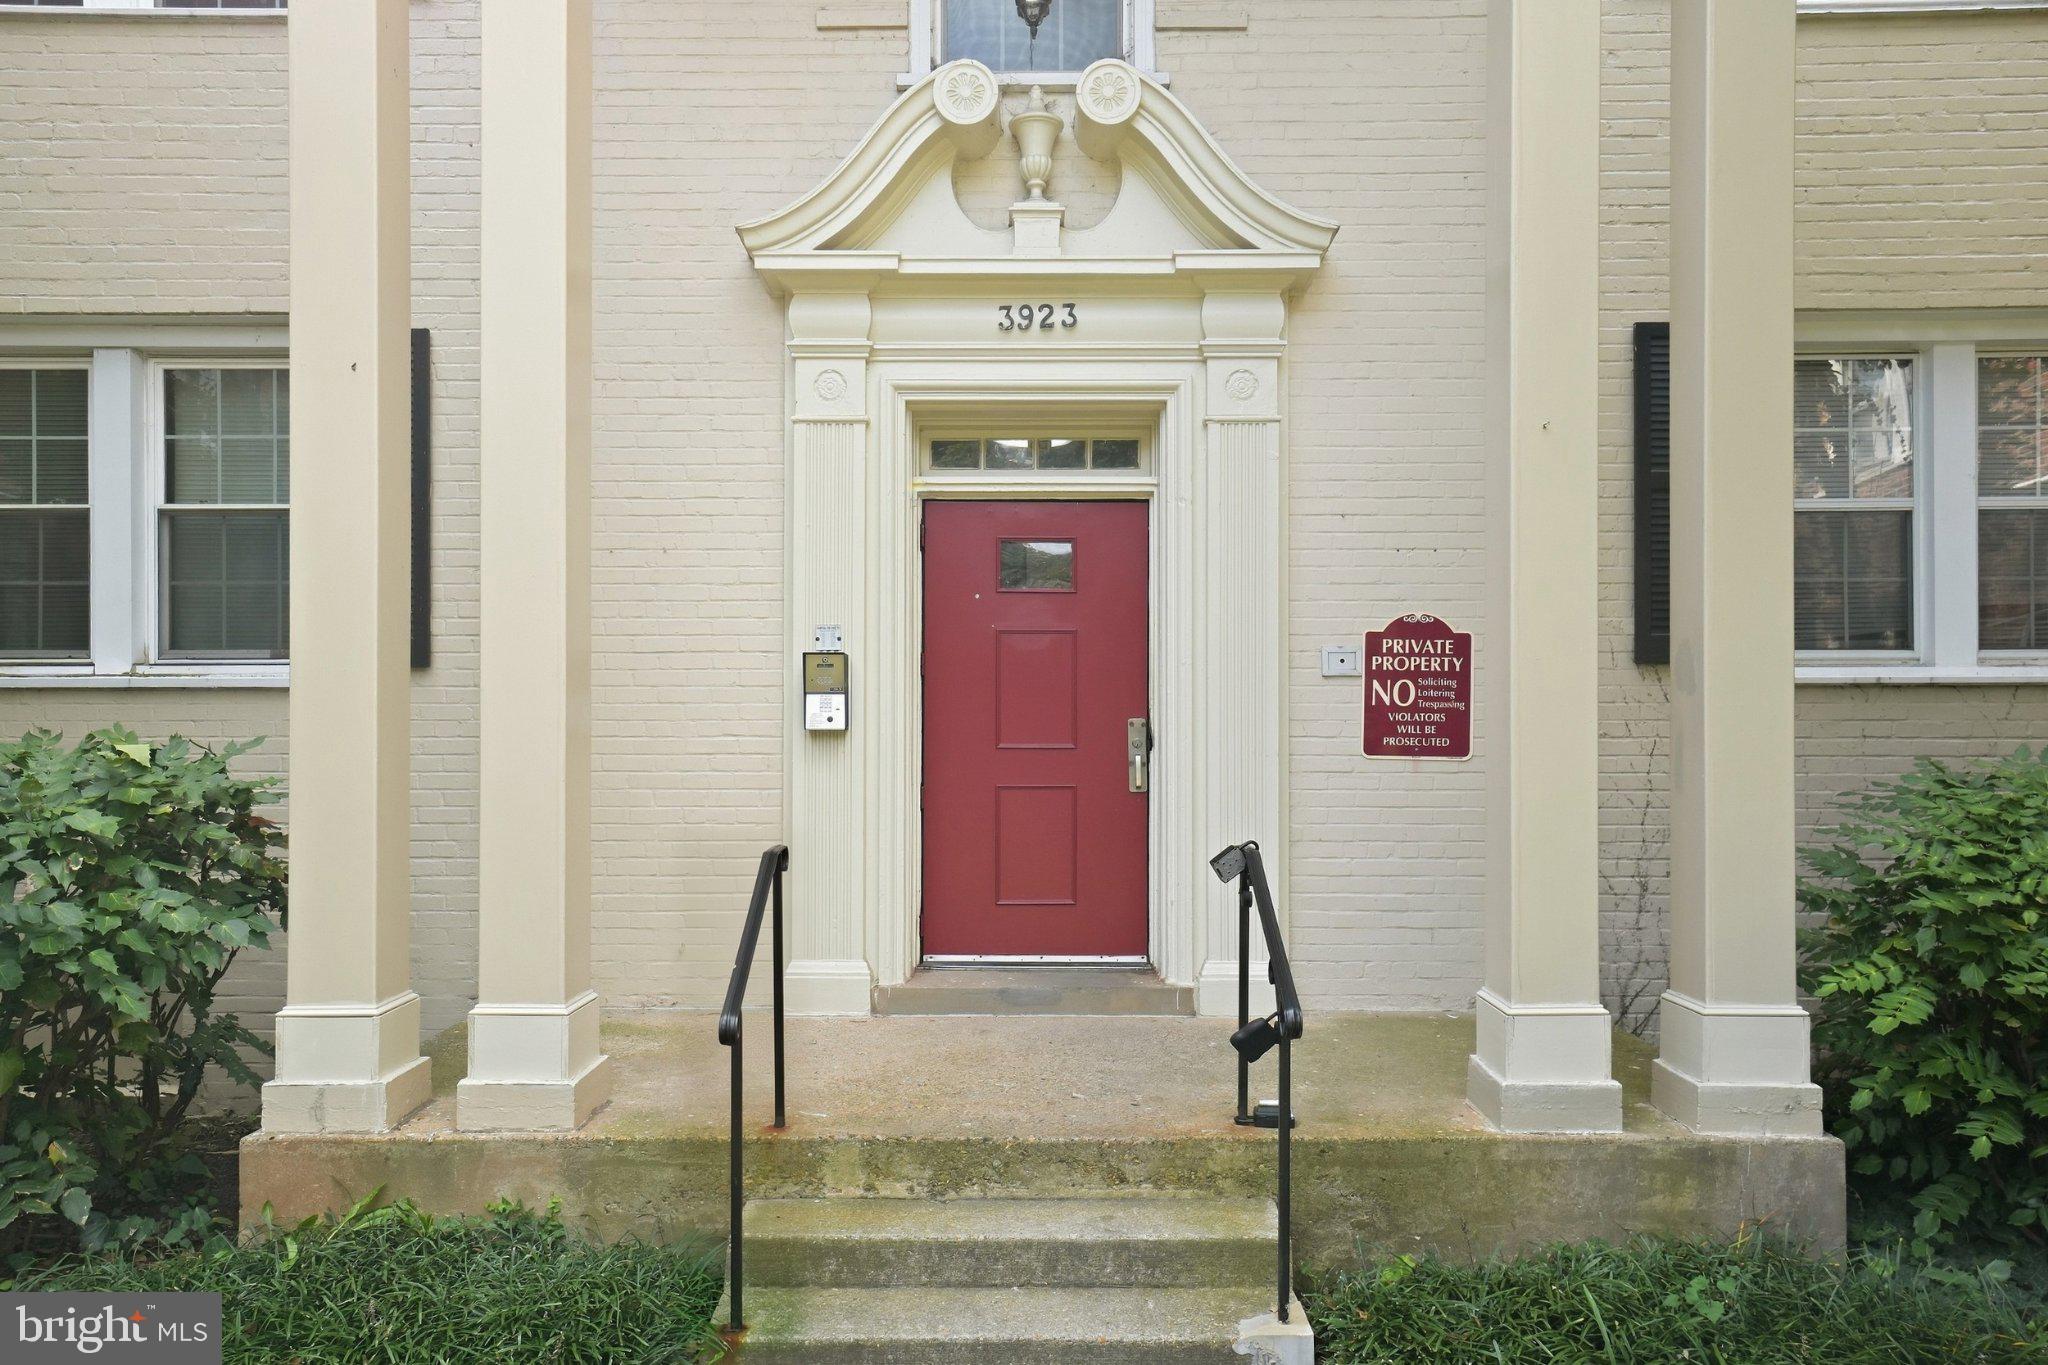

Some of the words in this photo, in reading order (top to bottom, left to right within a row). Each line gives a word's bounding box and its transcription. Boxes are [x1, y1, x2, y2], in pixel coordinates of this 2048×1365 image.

[998, 302, 1078, 331] 3923
[1382, 638, 1454, 654] PRIVATE
[1372, 656, 1463, 672] PROPERTY
[1417, 677, 1457, 688] Soliciting
[1371, 679, 1416, 707] NO
[1417, 688, 1456, 700] Loitering
[1417, 700, 1465, 710] Trespassing
[1388, 712, 1446, 722] VIOLATORS
[1397, 725, 1422, 734] WILL
[1424, 725, 1437, 734] BE
[1383, 737, 1450, 747] PROSECUTED
